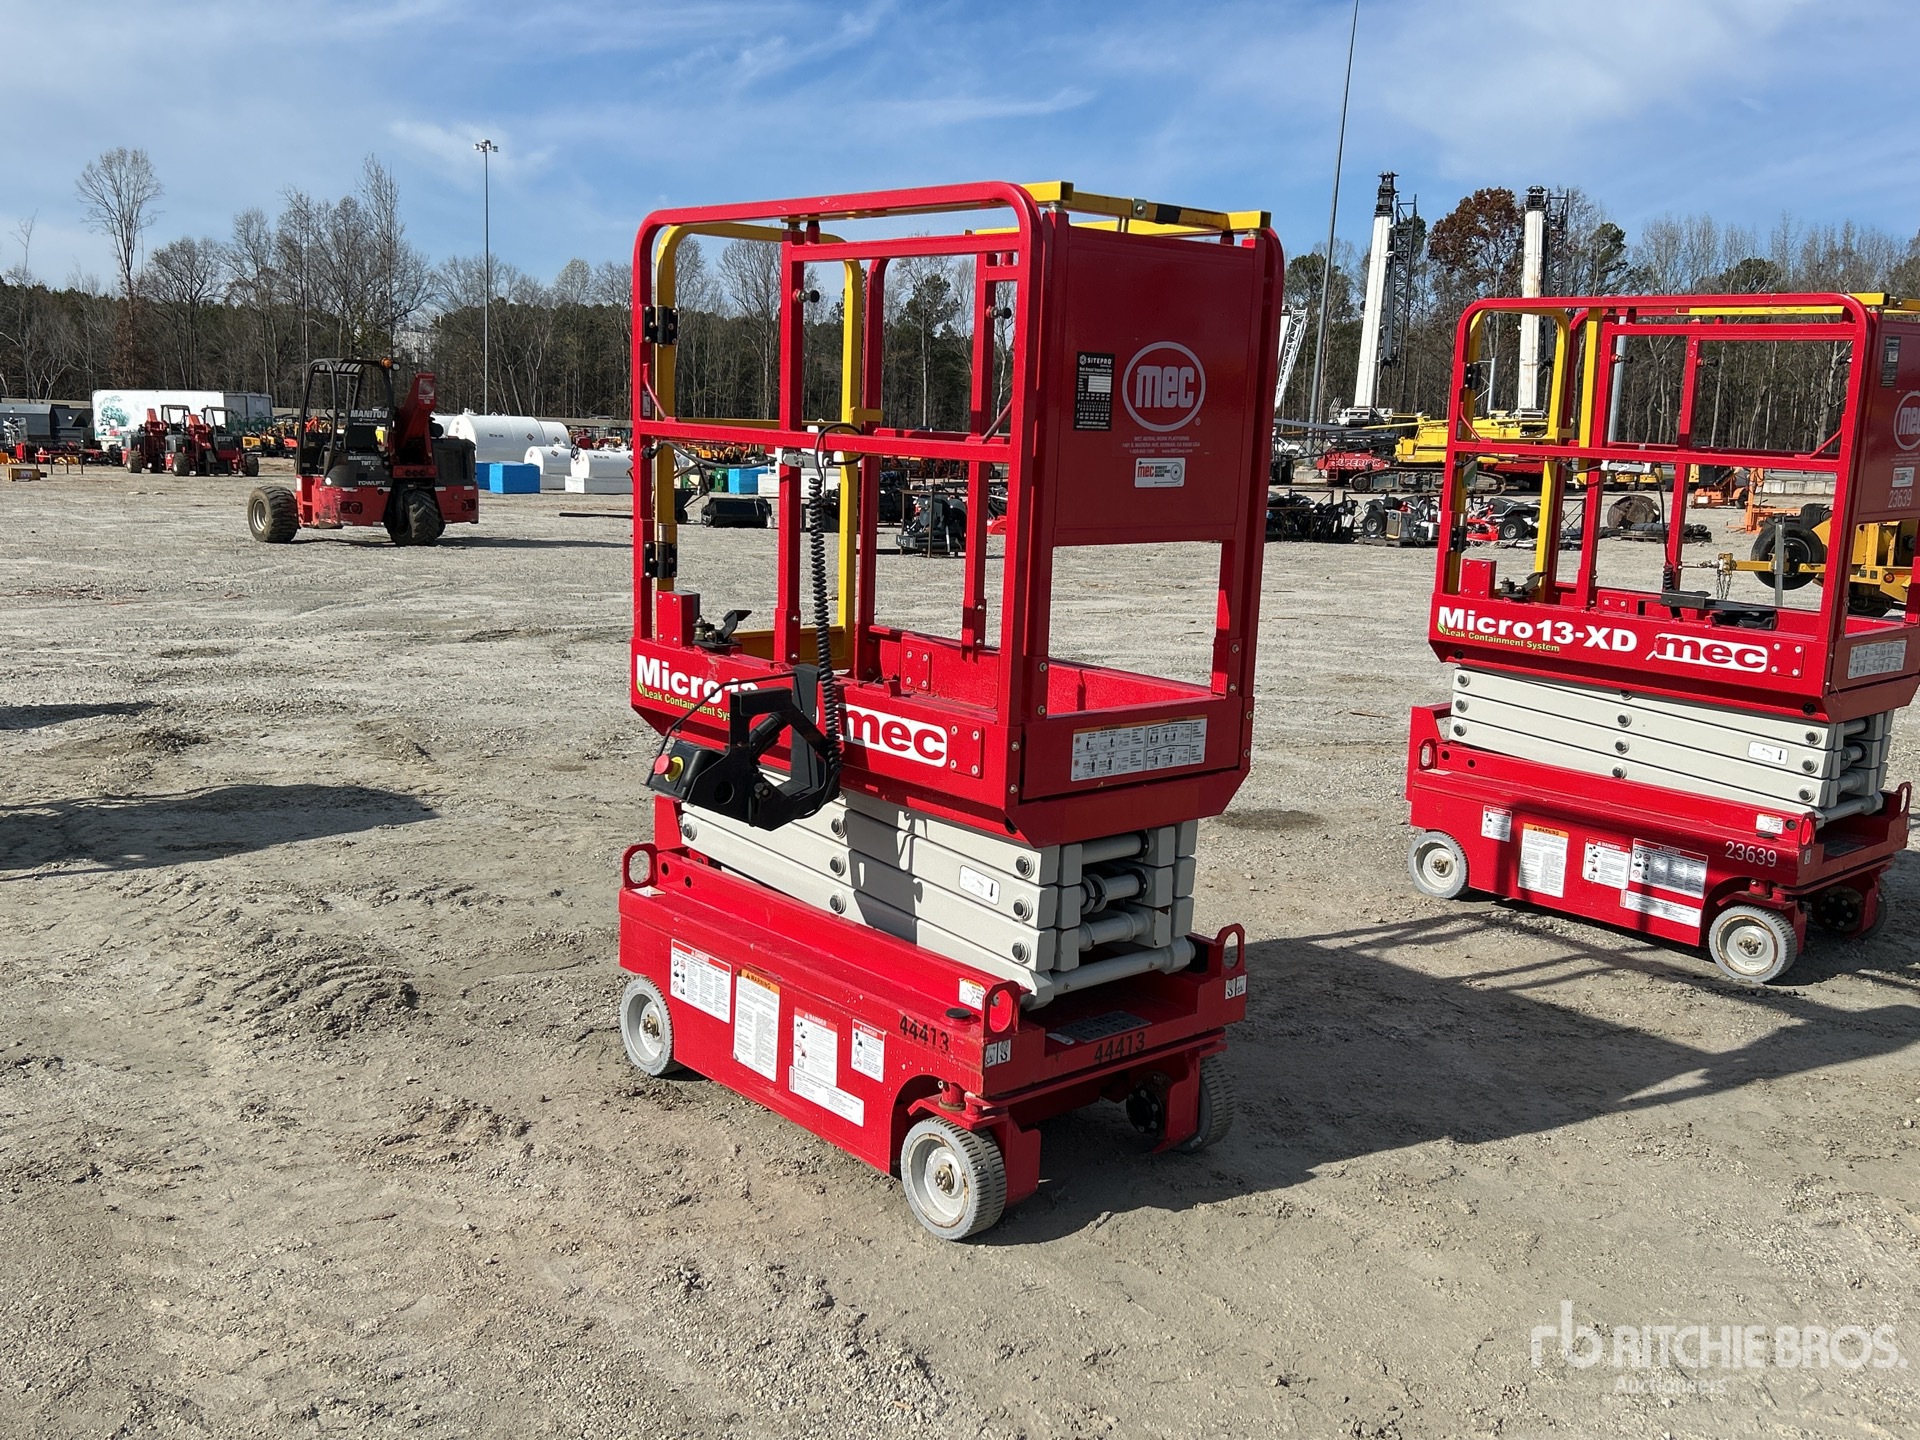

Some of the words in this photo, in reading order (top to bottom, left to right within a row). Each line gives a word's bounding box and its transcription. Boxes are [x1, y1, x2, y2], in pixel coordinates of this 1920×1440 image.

[1087, 357, 1112, 365] SITEPRO
[350, 410, 388, 419] MANITOU
[1888, 489, 1913, 508] 23639
[1438, 606, 1638, 652] Micro13-XD
[1445, 628, 1466, 638] Leak
[1468, 632, 1525, 648] Containment
[1526, 640, 1560, 652] System
[1656, 636, 1765, 668] mec
[645, 686, 663, 702] Leak
[717, 706, 731, 722] Sys
[1538, 827, 1559, 836] WARNING
[1602, 841, 1620, 850] DANGER
[1724, 840, 1777, 868] 23639
[751, 975, 771, 990] WARNING
[808, 1014, 827, 1027] DANGER
[899, 1014, 950, 1053] 44413
[1093, 1031, 1146, 1064] 44413
